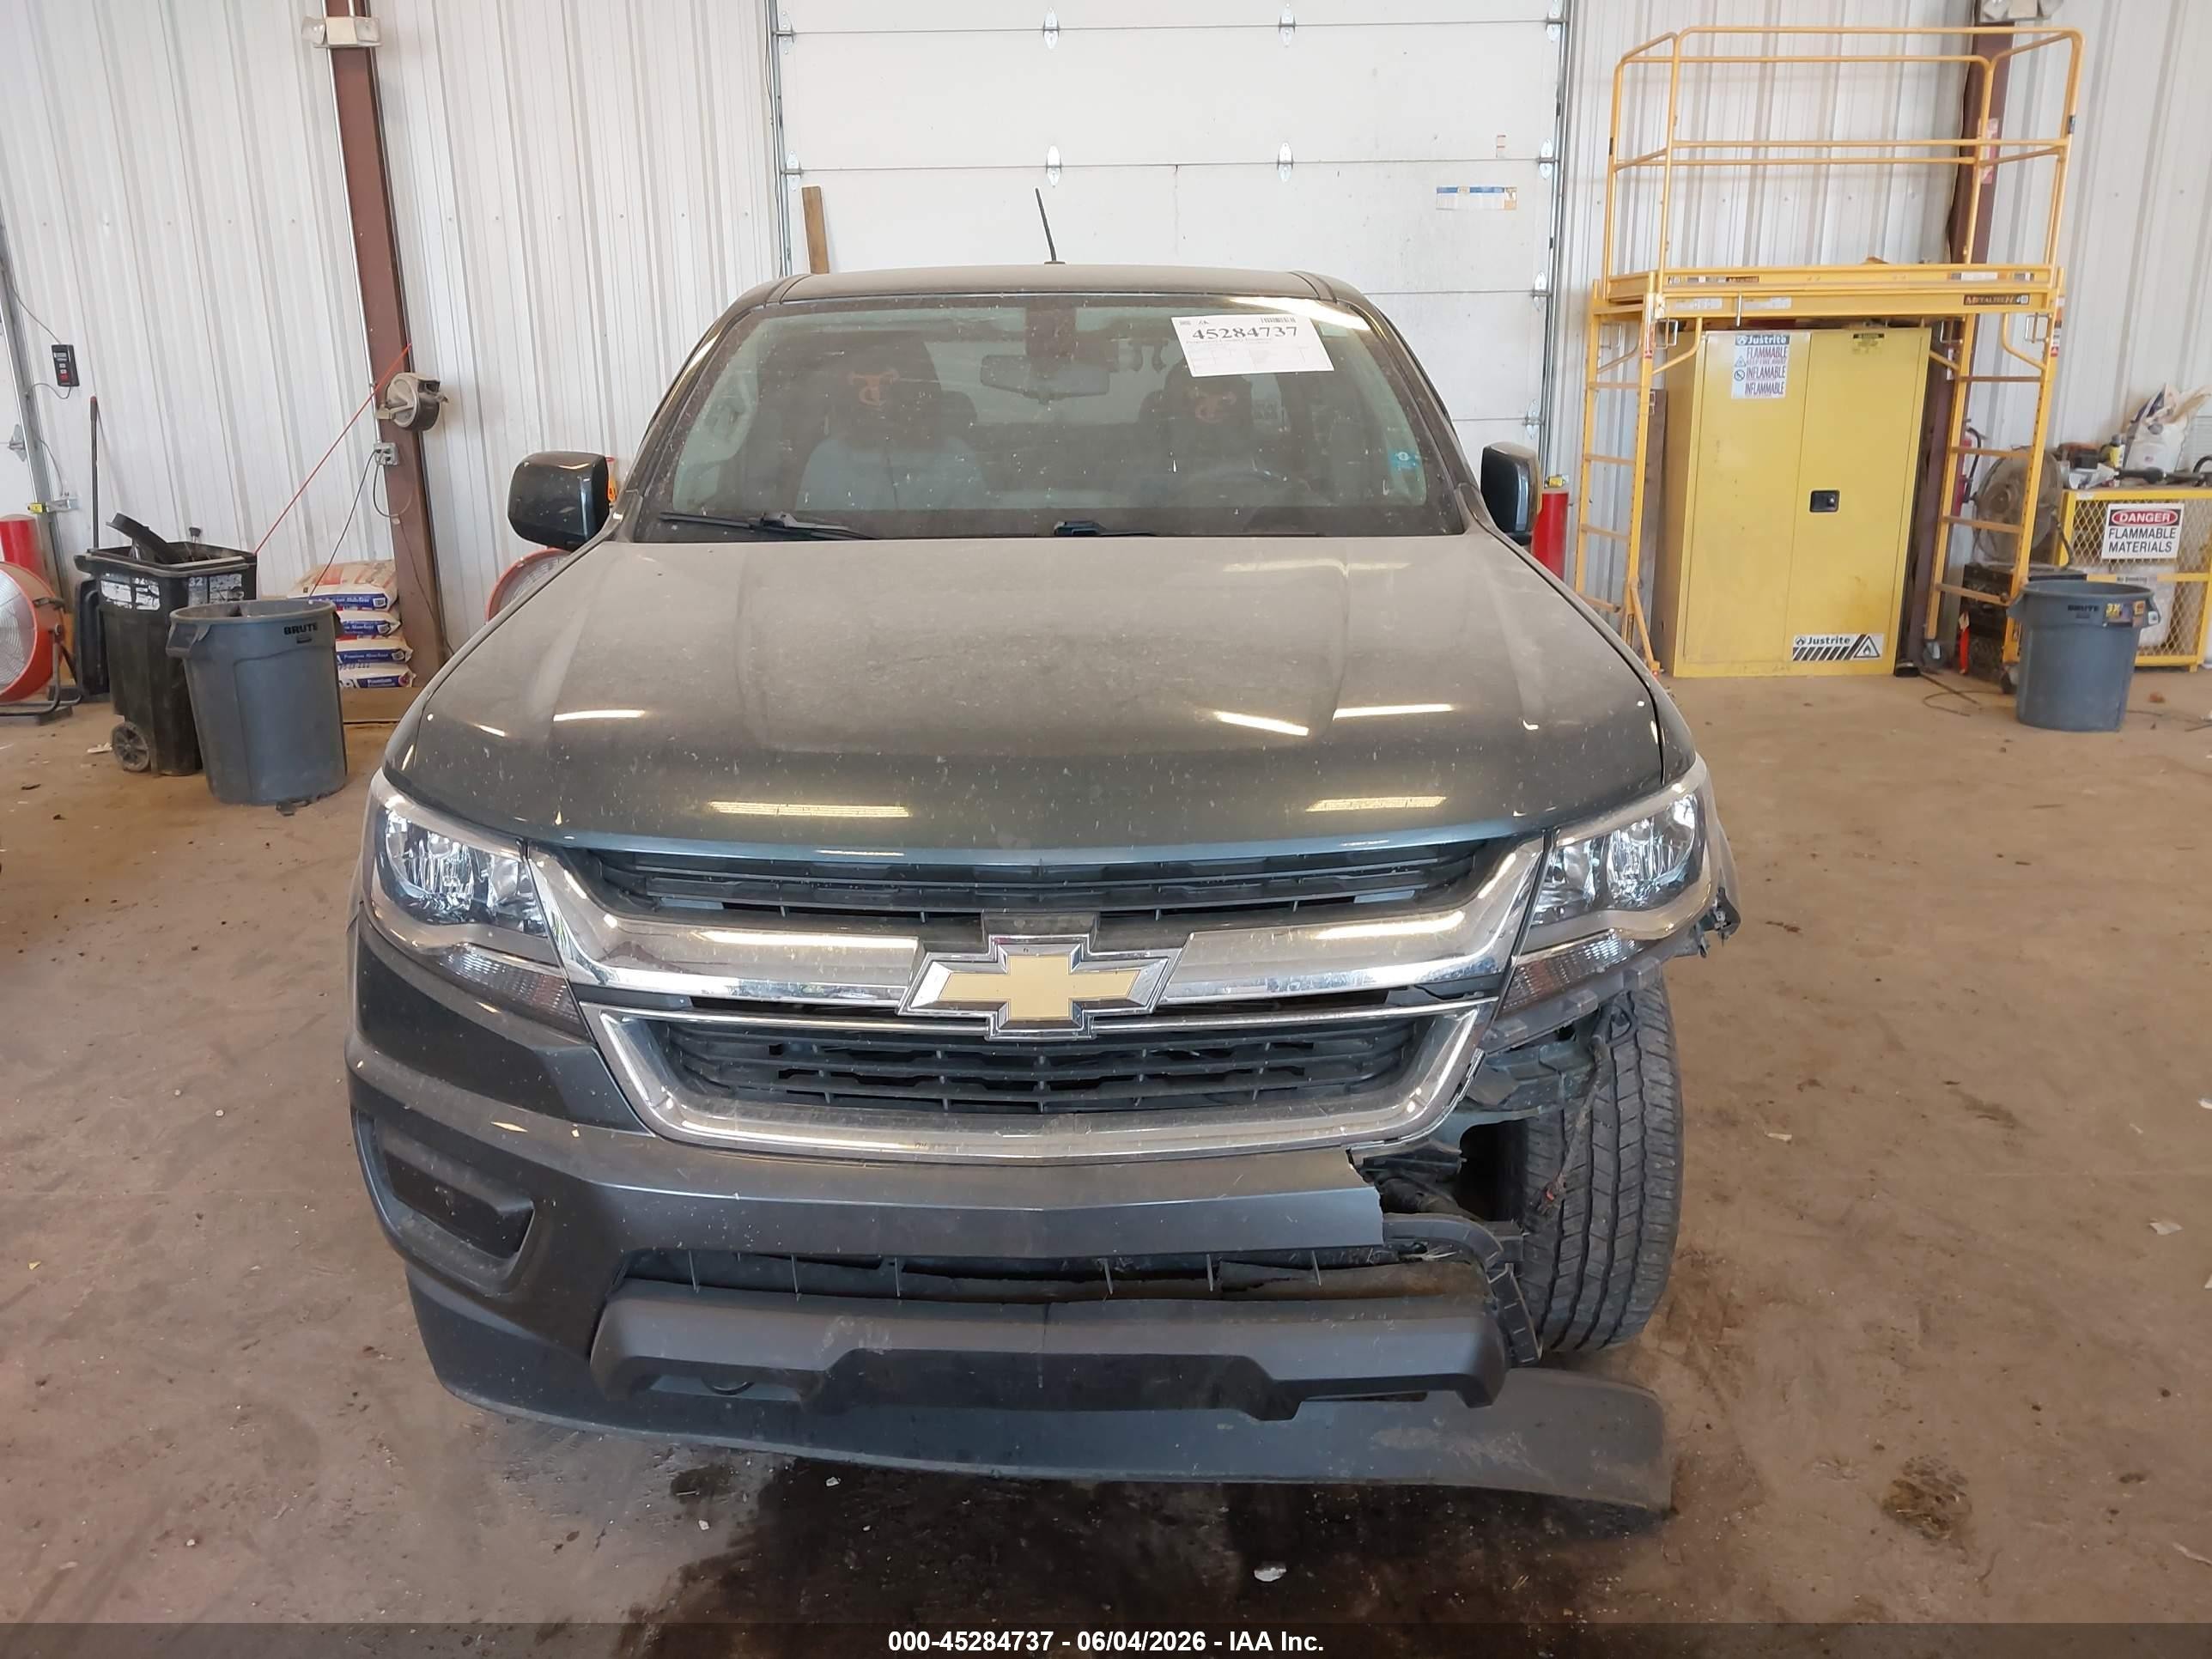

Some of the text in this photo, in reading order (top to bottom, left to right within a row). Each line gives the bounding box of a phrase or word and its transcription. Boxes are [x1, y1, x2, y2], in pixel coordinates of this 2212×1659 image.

[1192, 326, 1297, 340] 45284737
[1747, 335, 1786, 345] Justrite
[1747, 347, 1787, 358] FLAMMABLE
[1747, 366, 1786, 379] INFLAMABLE
[1745, 381, 1784, 395] INFLAMMABLE
[2119, 513, 2171, 523] DANGER
[2108, 527, 2177, 539] FLAMMABLE
[2108, 541, 2172, 553] MATERIALS
[284, 623, 318, 635] BRUTE
[1808, 635, 1850, 645] Justrite
